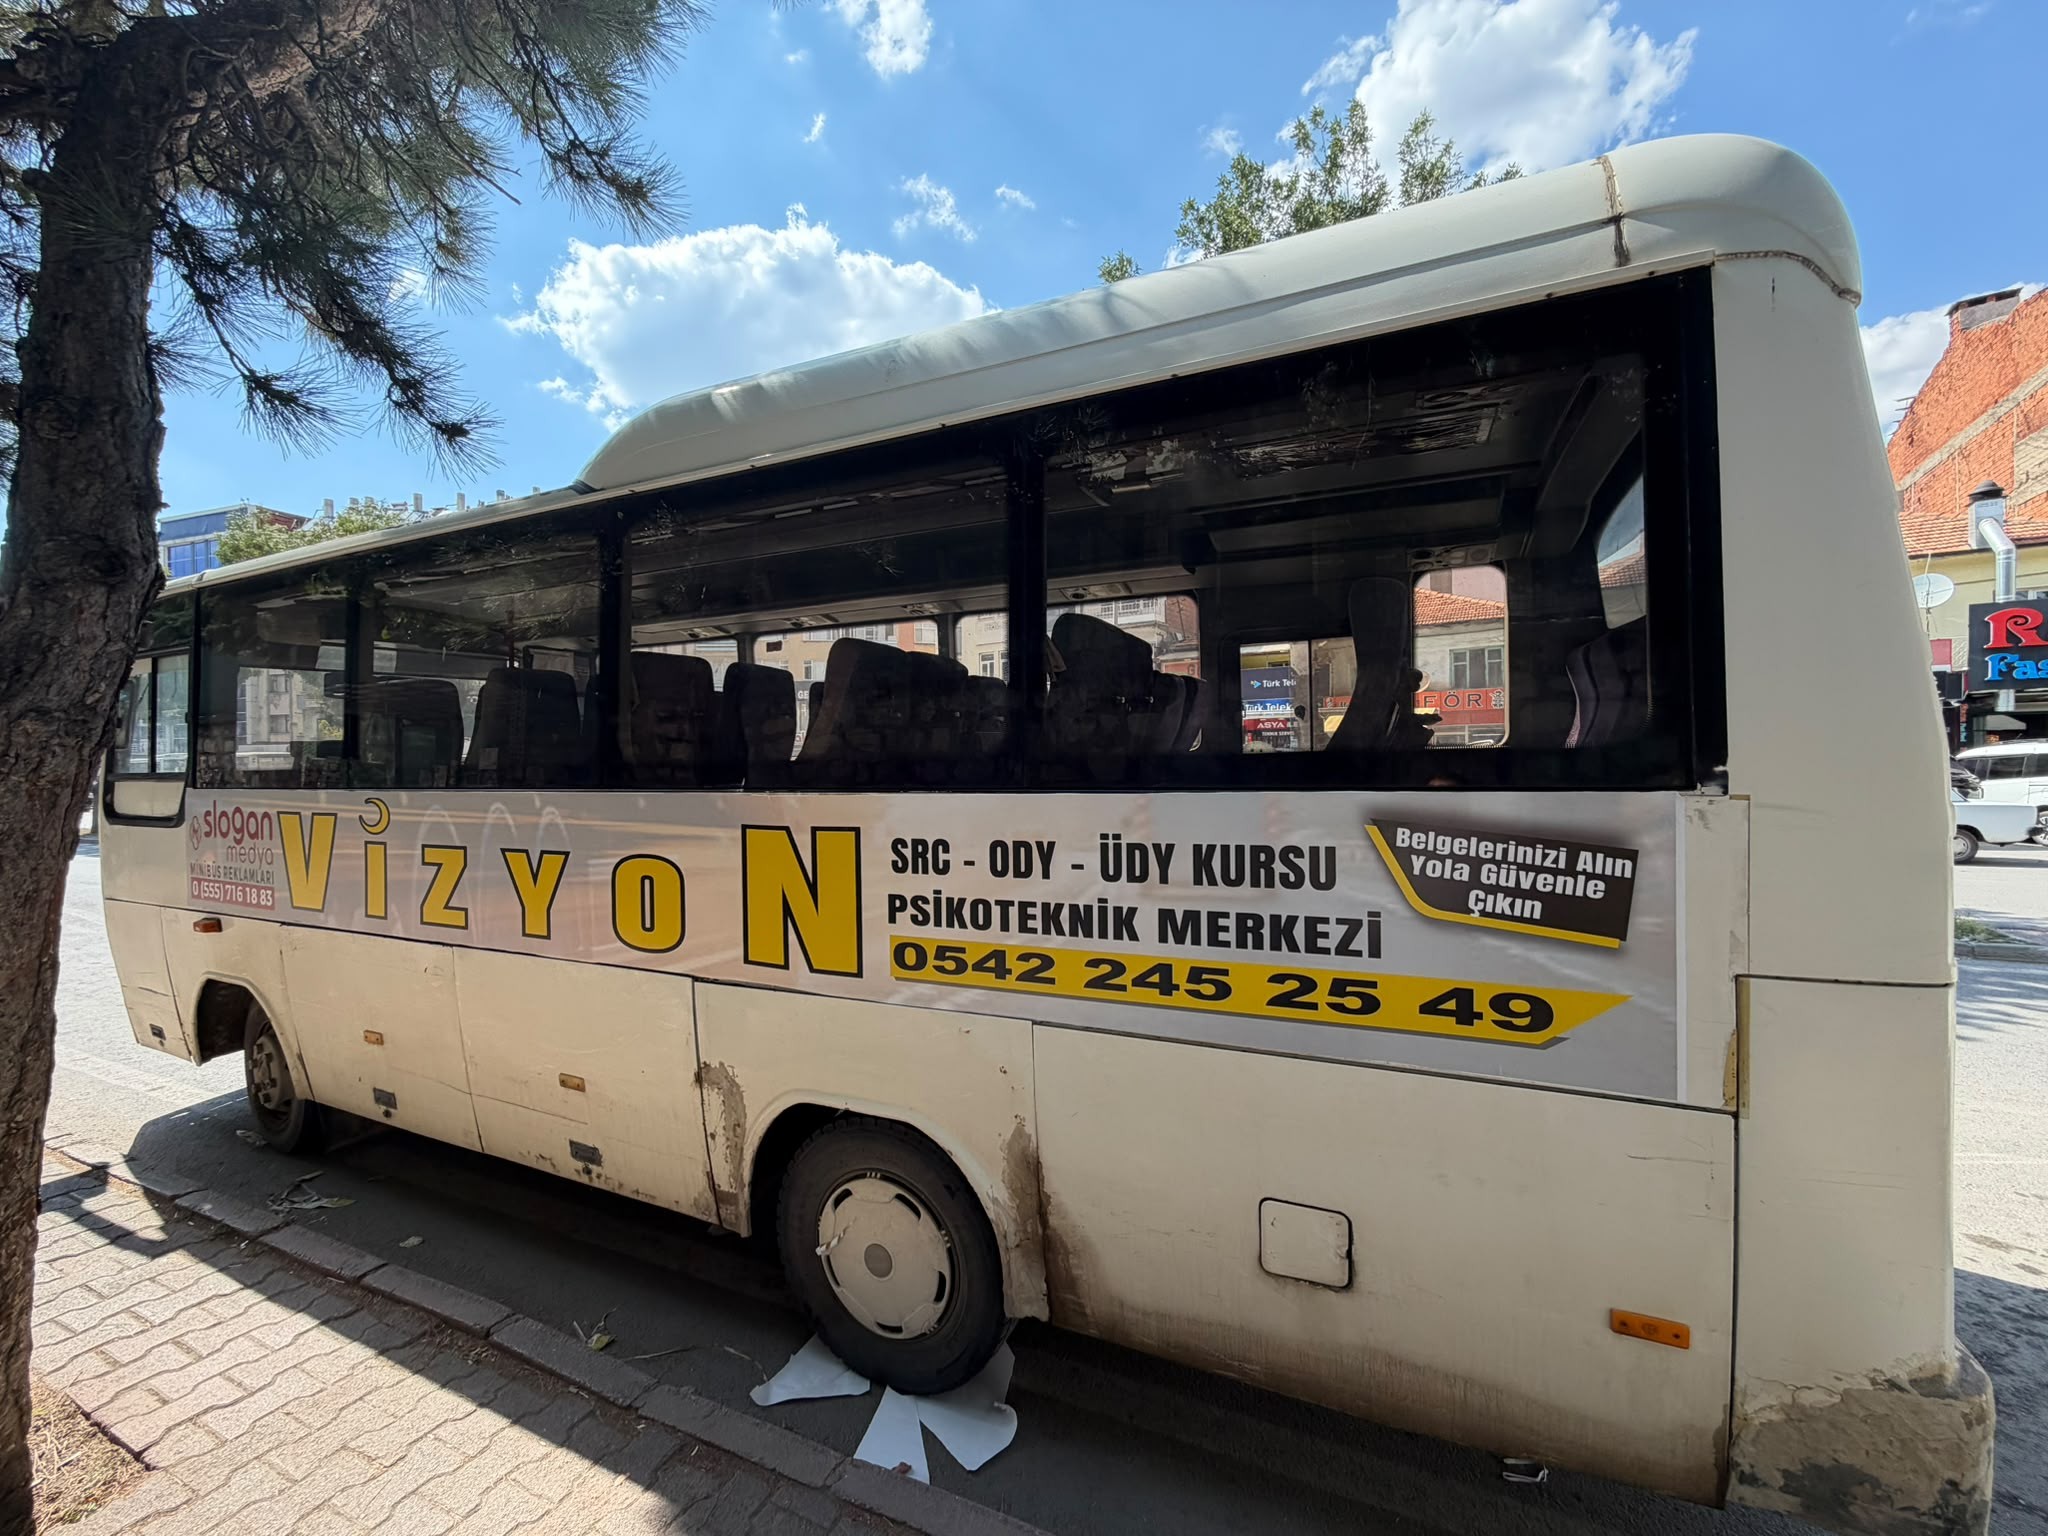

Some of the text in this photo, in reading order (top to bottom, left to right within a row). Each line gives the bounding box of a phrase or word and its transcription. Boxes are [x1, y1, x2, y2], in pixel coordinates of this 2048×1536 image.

[1262, 680, 1281, 688] Türk
[1265, 702, 1294, 711] Telek
[1416, 690, 1483, 708] FÖR
[1256, 721, 1285, 729] ASYA
[204, 800, 273, 846] slogan
[226, 842, 274, 870] medya
[891, 837, 950, 876] SRC
[989, 839, 1057, 880] ODY
[1100, 832, 1175, 885] ÜDY
[1192, 843, 1337, 891] KURSU
[1395, 826, 1634, 879] Belgelerinizi Alın
[223, 865, 275, 886] REKLAMLARI
[1410, 853, 1607, 900] Yola Güvenle
[192, 880, 273, 907] 0 (555) 716 18 83
[1467, 889, 1543, 920] Çıkın
[888, 889, 1382, 960] PSİKOTEKNİK MERKEZİ
[893, 942, 1555, 1034] 0542 245 25 49
